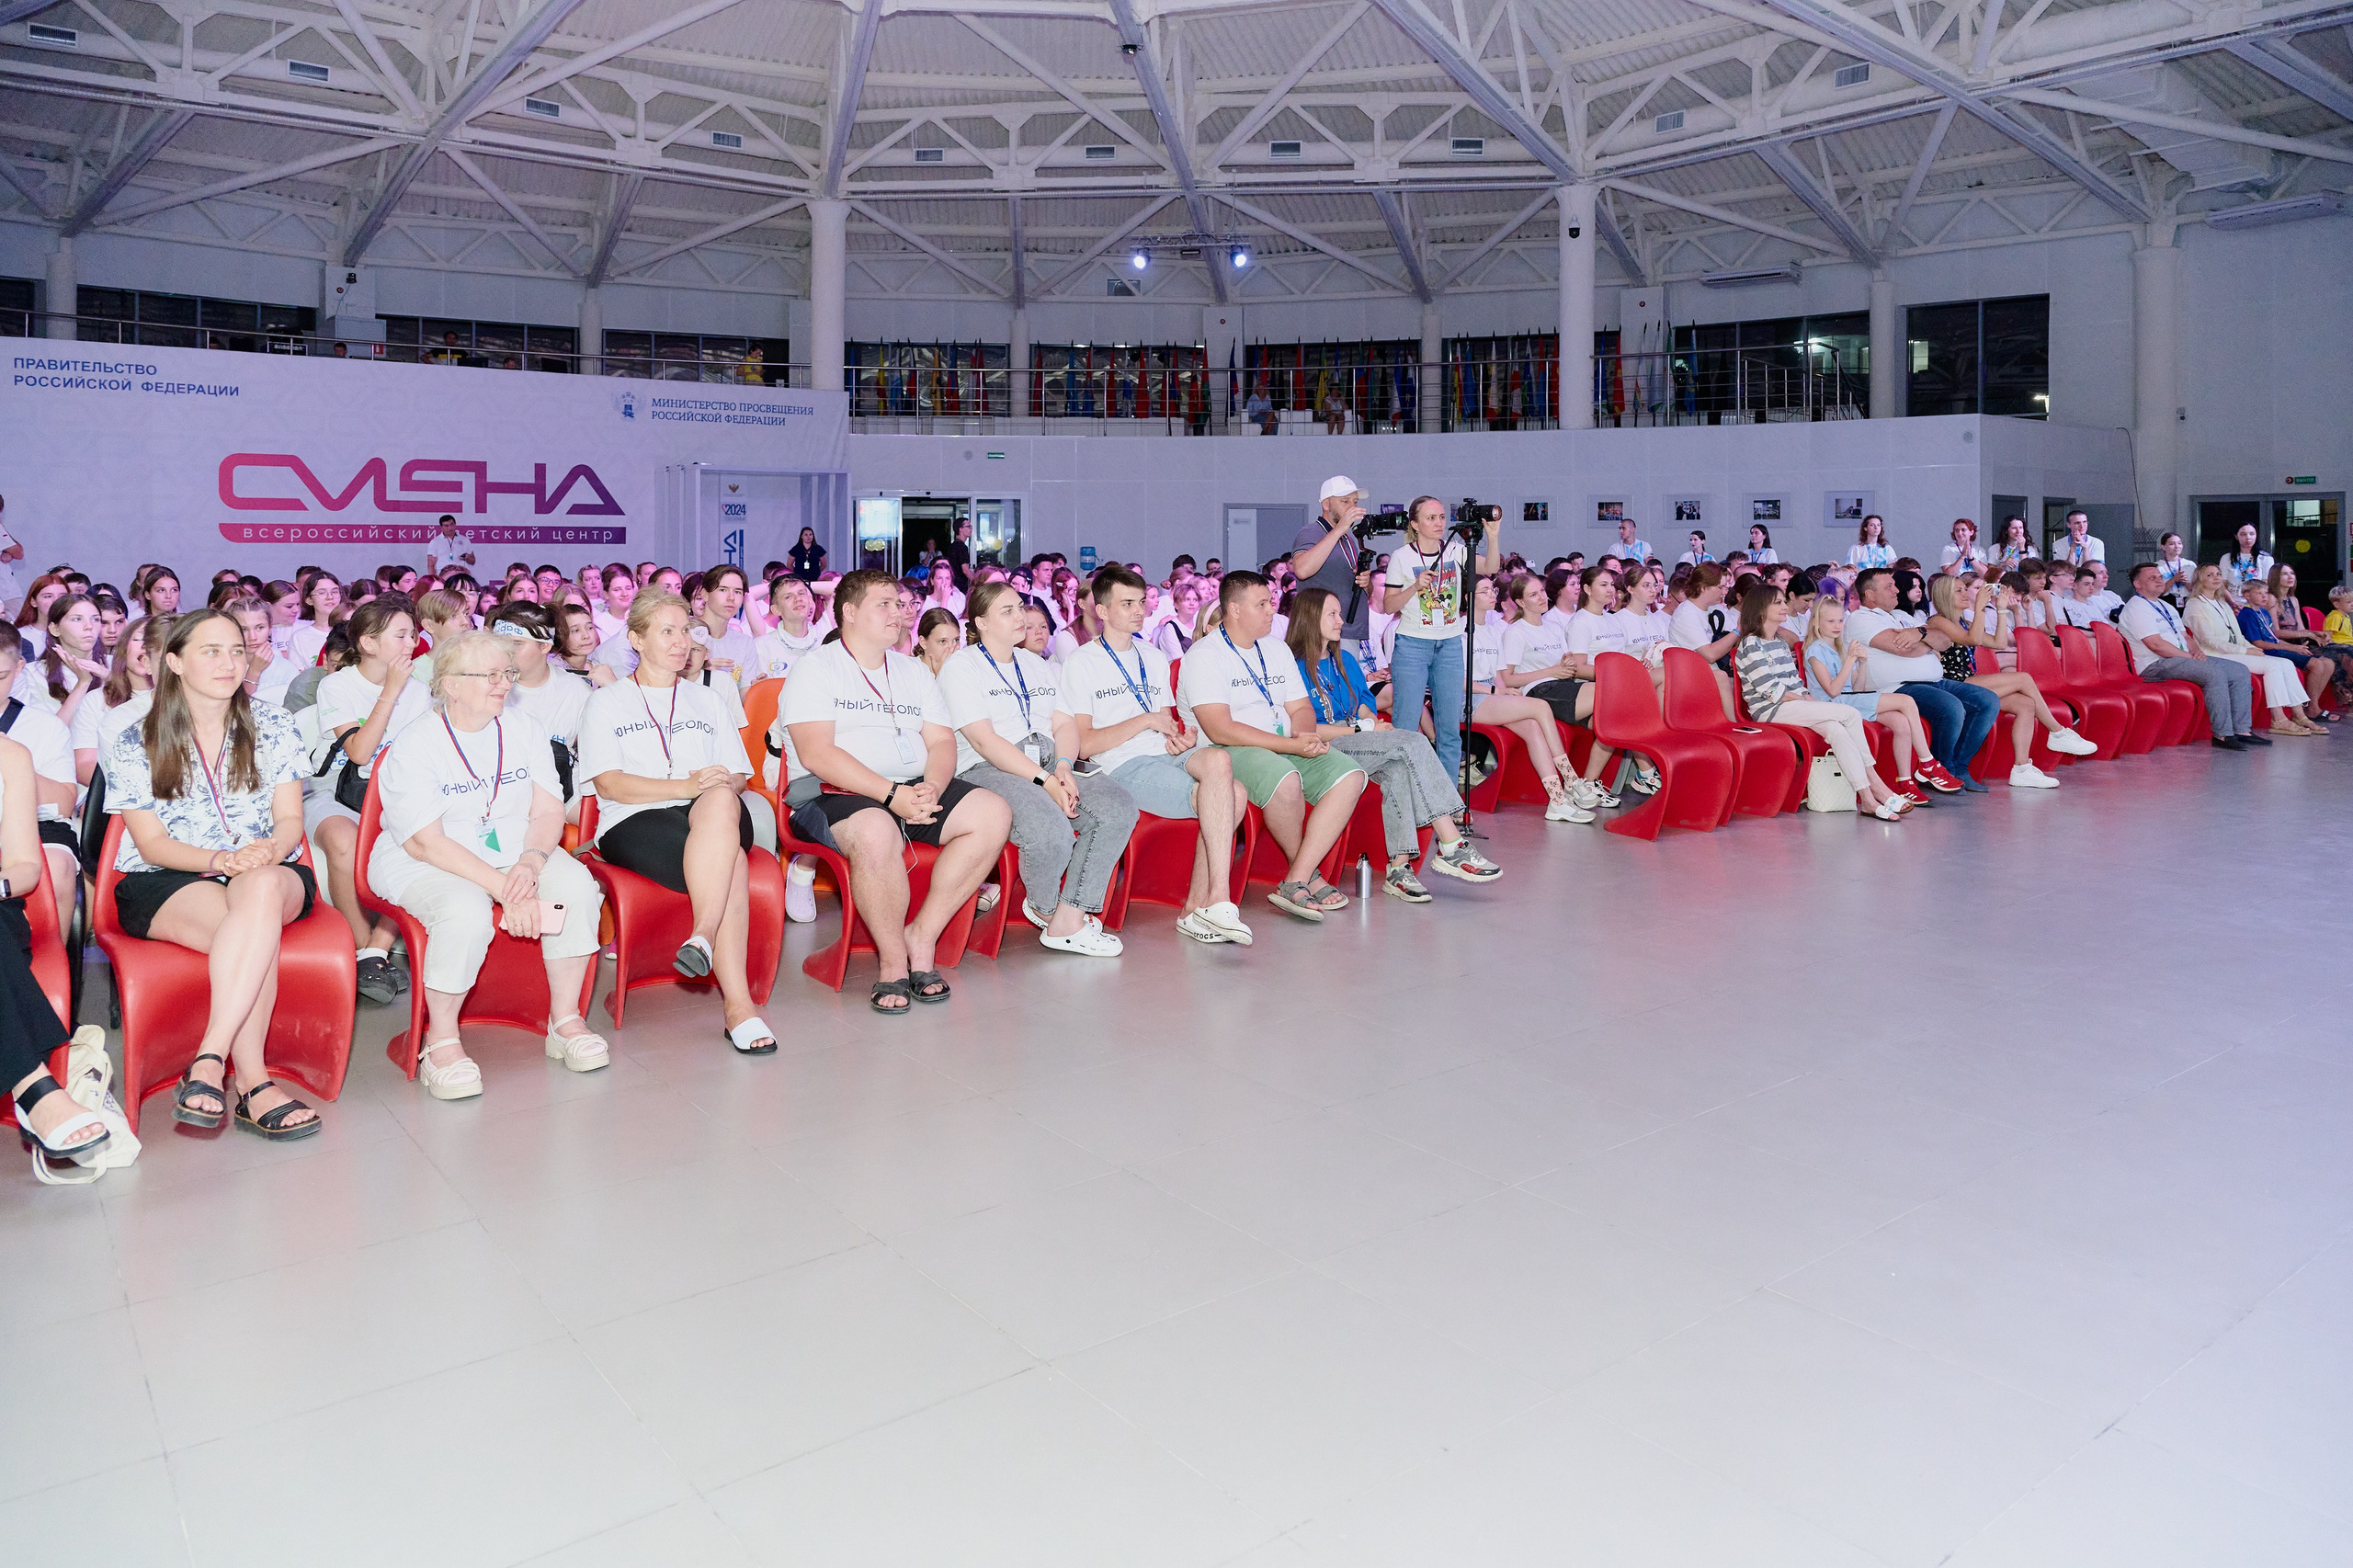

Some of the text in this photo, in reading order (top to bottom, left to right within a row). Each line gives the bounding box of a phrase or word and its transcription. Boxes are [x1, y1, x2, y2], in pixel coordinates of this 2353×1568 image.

[14, 358, 157, 375] ПРАВИТЕЛЬСТВО
[14, 375, 239, 397] РОССИЙСКОЙ ФЕДЕРАЦИИ
[652, 398, 813, 415] МИНИСТЕРСТВО ПРОСВЕЩЕНИЯ
[652, 411, 786, 426] РОССИЙСКОЙ ФЕДЕРАЦИИ
[219, 453, 626, 516] СМЕНА
[724, 504, 746, 516] 2024
[243, 525, 613, 543] всероссийский етский центр
[1096, 683, 1131, 699] ЮНЫЙ
